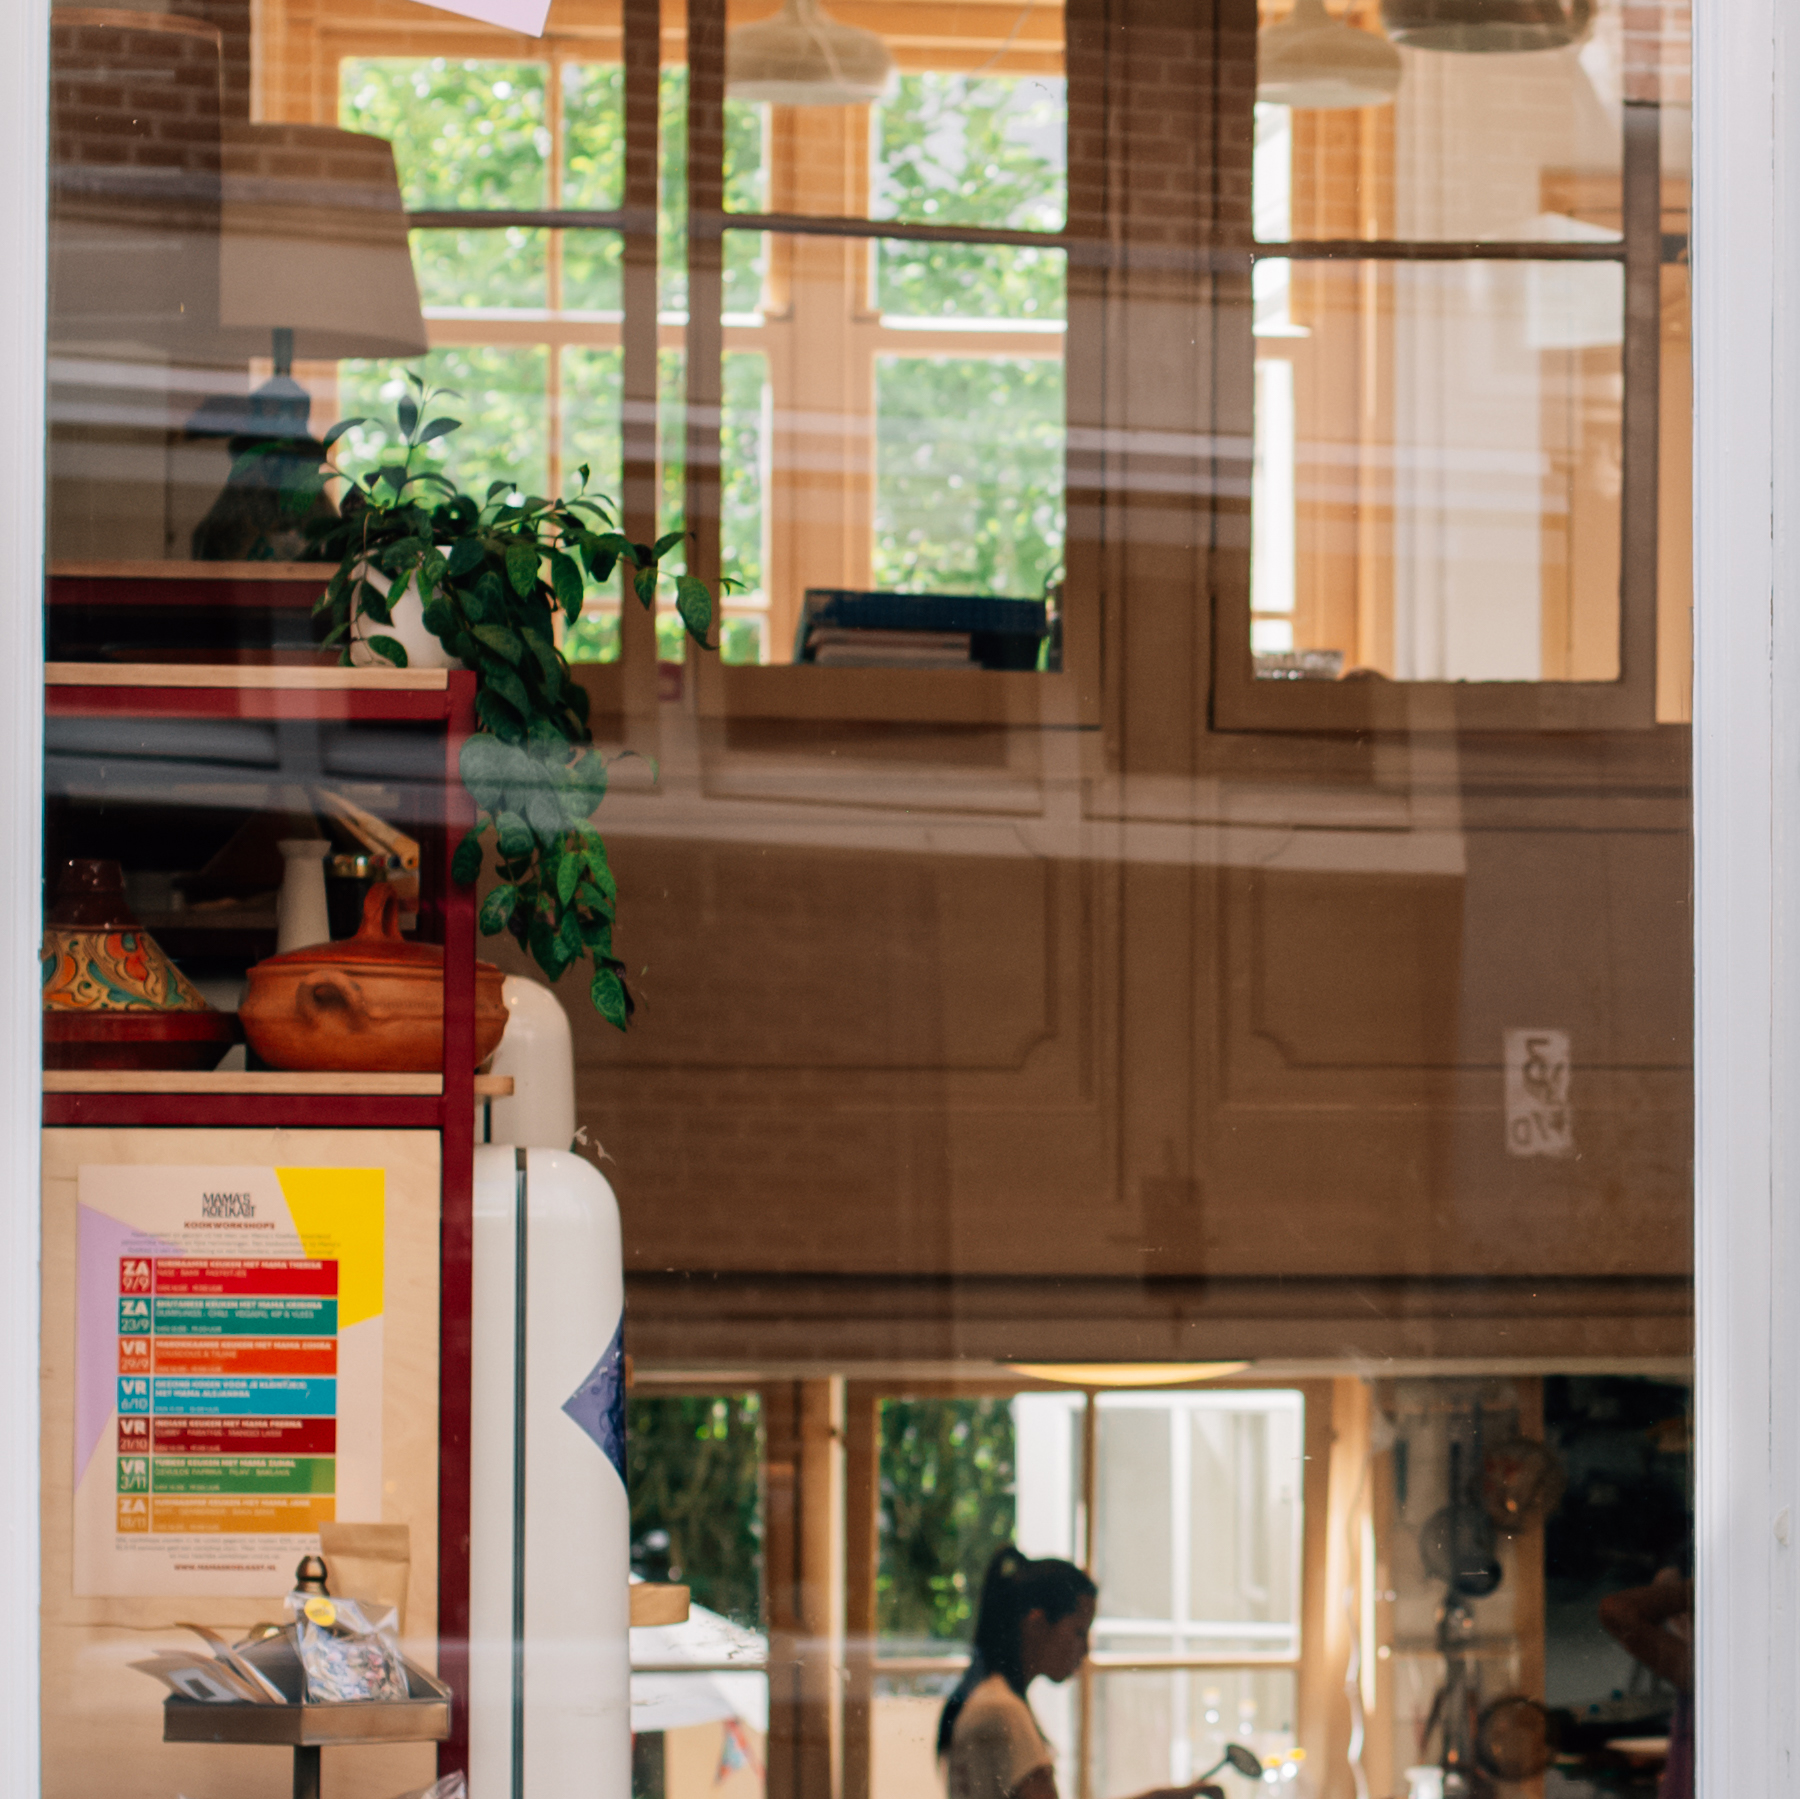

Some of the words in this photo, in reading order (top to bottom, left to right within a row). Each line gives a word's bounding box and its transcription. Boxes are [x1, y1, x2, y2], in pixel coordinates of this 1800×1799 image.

[122, 1260, 149, 1277] ZA
[123, 1276, 149, 1291] 9/9
[121, 1301, 148, 1316] ZA
[121, 1318, 149, 1332] 23/9
[121, 1340, 147, 1355] VR
[121, 1380, 147, 1395] VR
[121, 1397, 148, 1411] 6/10
[120, 1419, 146, 1435] VR
[120, 1459, 146, 1475] VR
[120, 1475, 147, 1490] 3/11
[120, 1499, 146, 1514] ZA
